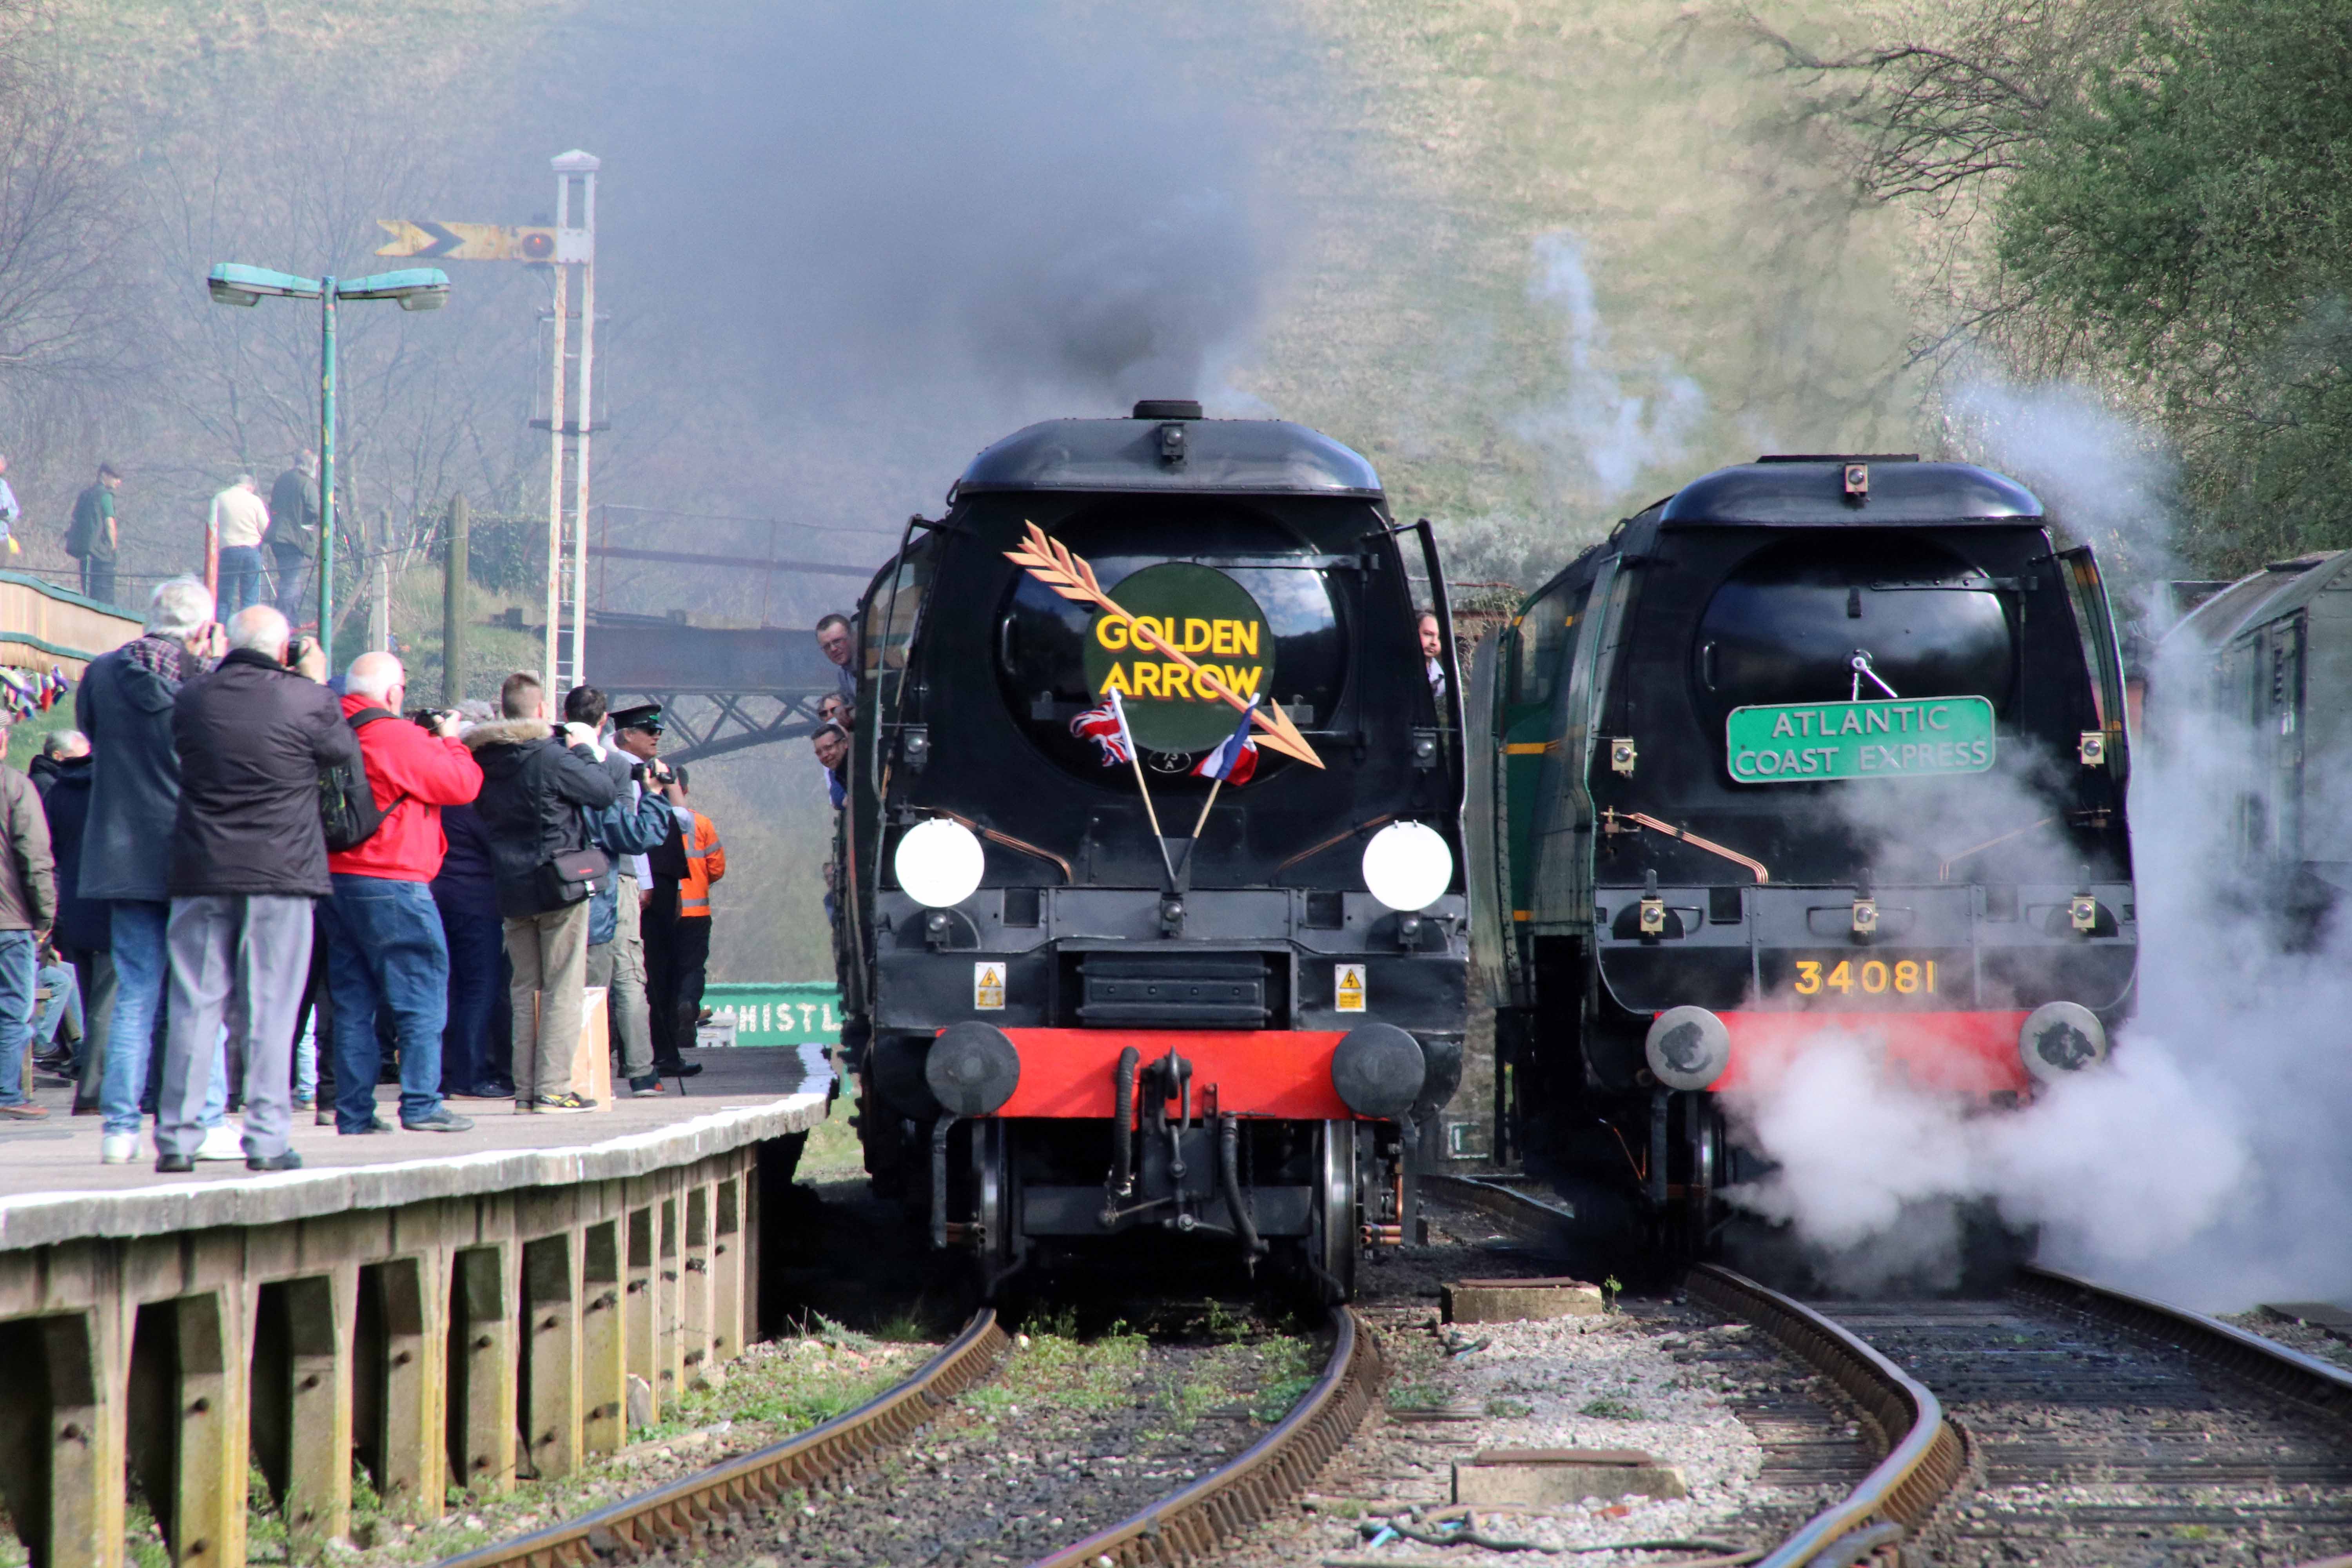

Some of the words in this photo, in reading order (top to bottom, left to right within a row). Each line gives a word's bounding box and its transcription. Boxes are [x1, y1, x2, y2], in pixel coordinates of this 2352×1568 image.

[1096, 615, 1259, 656] GOLDEN
[1100, 661, 1262, 700] ARROW
[1772, 706, 1949, 738] ATLANTIC
[1165, 760, 1174, 769] A
[1736, 747, 1839, 775] COAST
[1860, 741, 1987, 771] EXPRESS
[1795, 960, 1937, 995] 34081
[704, 1003, 841, 1033] HISTL
